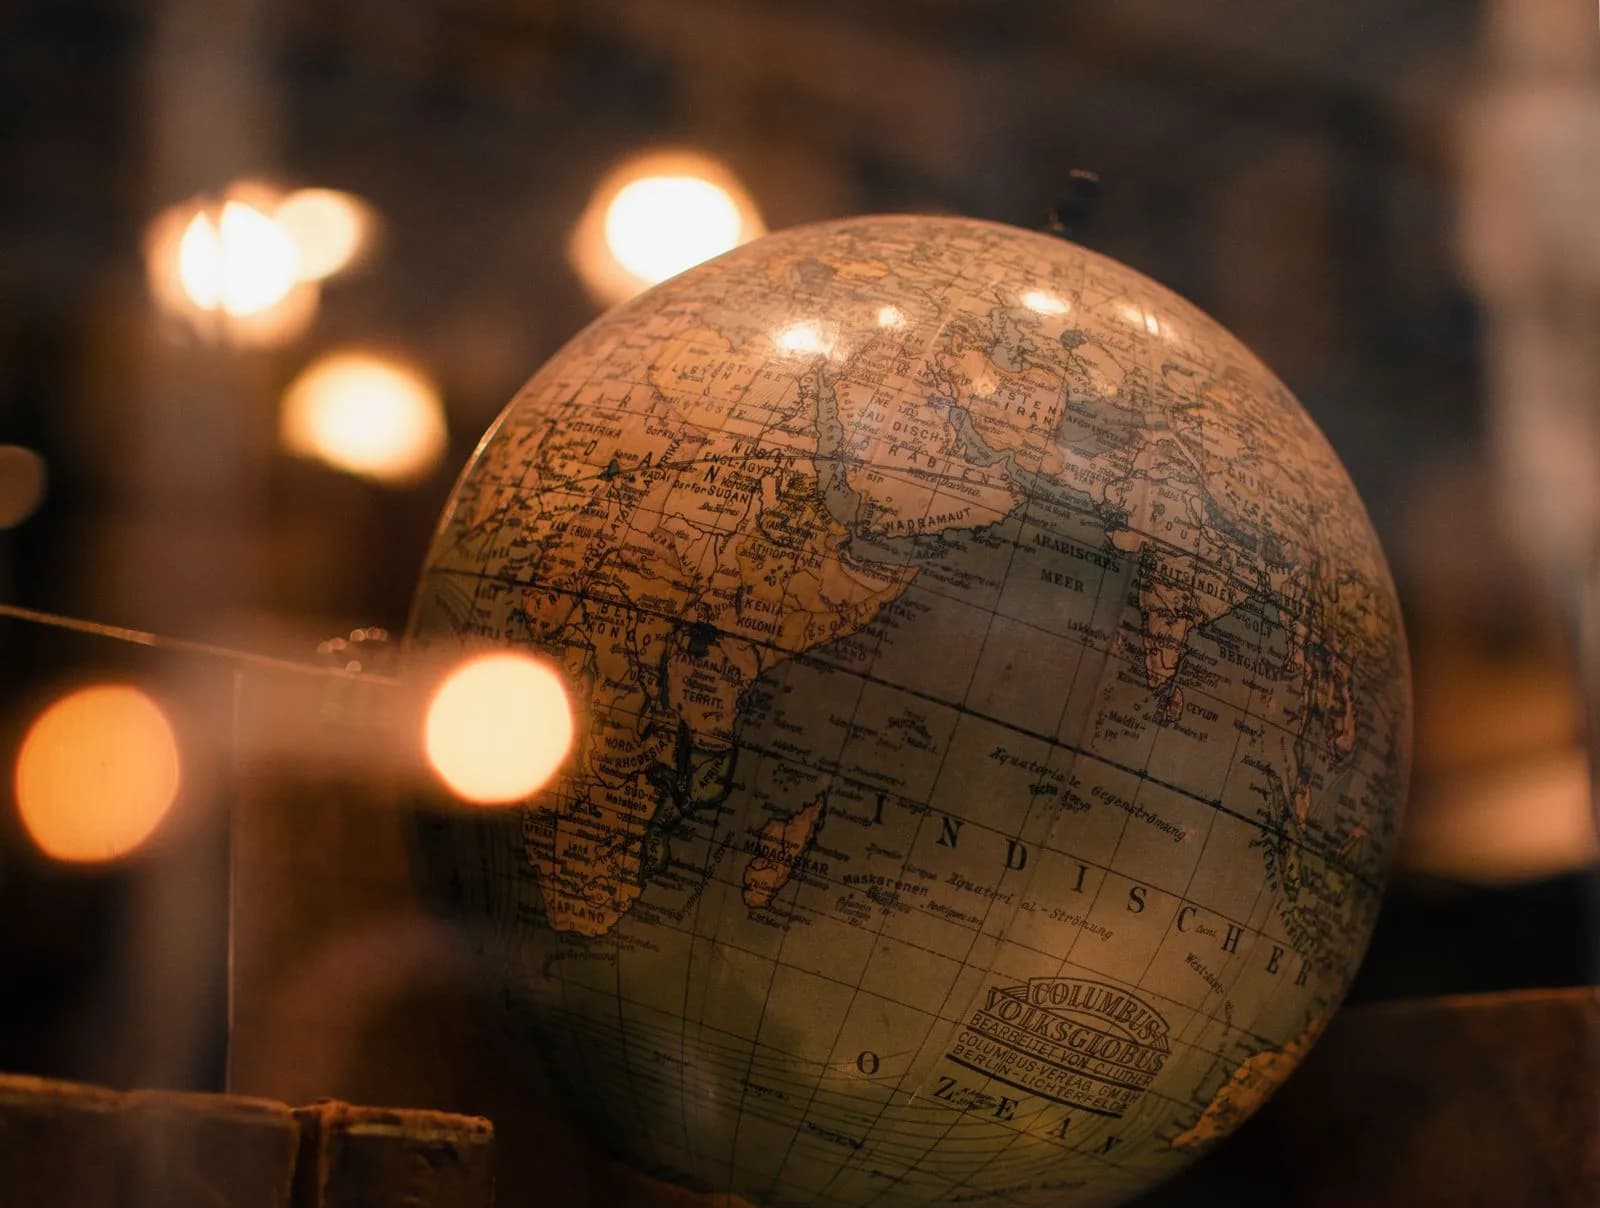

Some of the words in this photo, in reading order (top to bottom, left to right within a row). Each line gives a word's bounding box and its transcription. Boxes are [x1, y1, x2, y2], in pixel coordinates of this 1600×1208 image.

[885, 507, 972, 532] HADRAMAUT
[1040, 568, 1084, 593] MEER
[984, 988, 1169, 1073] VOLKSGLOBUS
[1031, 981, 1161, 1042] COLUMBUS
[970, 1013, 1059, 1057] BEARBEITET
[1060, 1049, 1089, 1069] VON
